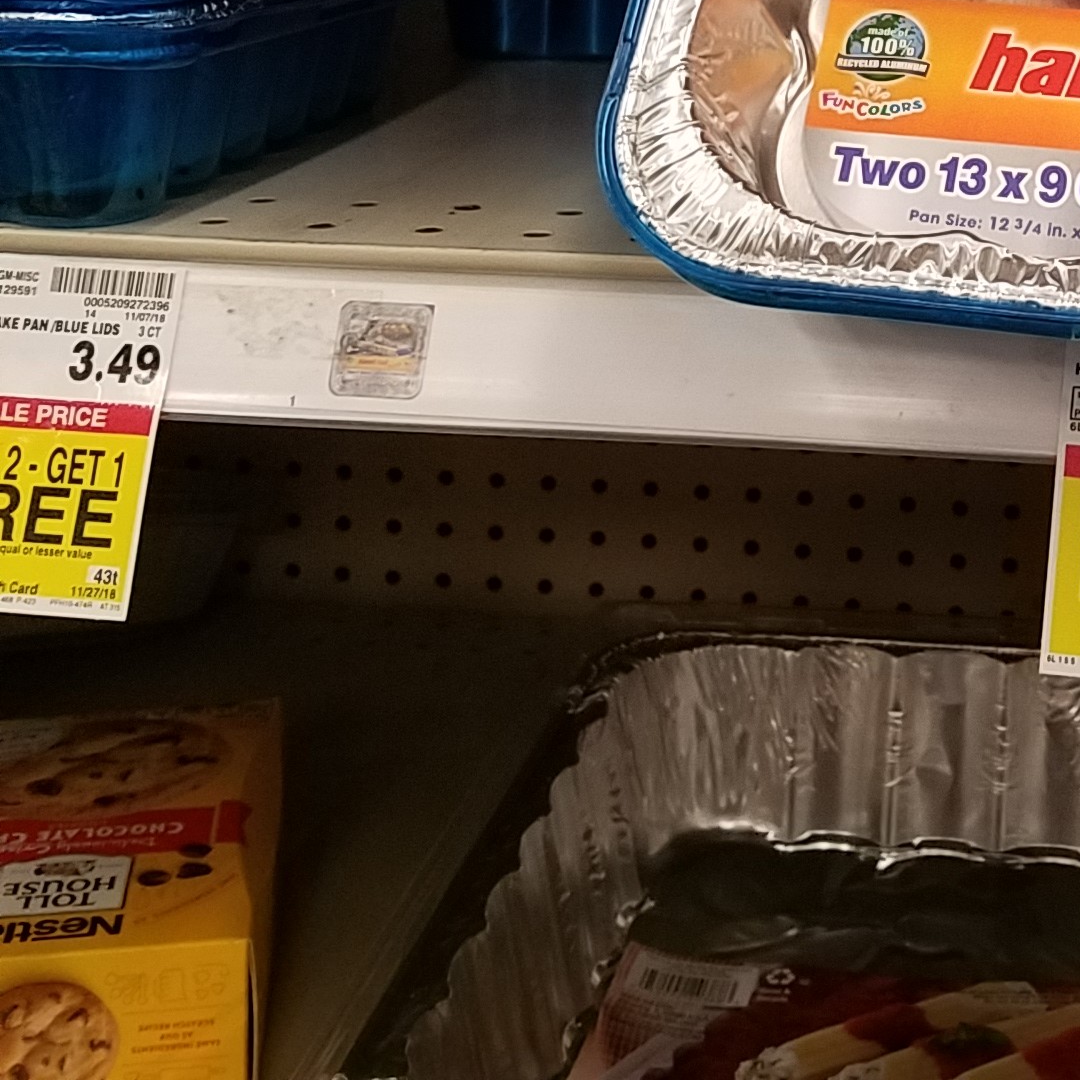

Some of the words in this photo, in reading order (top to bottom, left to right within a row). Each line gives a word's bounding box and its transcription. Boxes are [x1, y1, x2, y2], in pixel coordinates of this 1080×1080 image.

[868, 26, 896, 35] made
[898, 28, 910, 37] of
[861, 36, 915, 57] 100%
[837, 57, 880, 69] RECYCLED
[881, 60, 928, 72] ALUMINUM
[834, 145, 926, 190] Two
[939, 157, 988, 196] 13
[1000, 171, 1029, 199] x
[1039, 166, 1068, 203] 9
[909, 209, 940, 225] Pan
[945, 213, 982, 230] Size:
[990, 217, 1010, 232] 12
[1014, 217, 1042, 237] 3/4
[1046, 222, 1068, 239] in.
[84, 297, 169, 311] 0005209272396
[85, 309, 96, 318] 14
[125, 312, 165, 323] 11/07/18
[23, 319, 49, 331] PAN
[92, 322, 120, 335] LIDS
[139, 325, 145, 336] 3
[148, 326, 161, 338] CT
[69, 340, 160, 385] 3.49
[36, 404, 108, 428] PRICE
[4, 445, 21, 480] 2
[47, 447, 105, 486] GET
[114, 452, 124, 487] 1
[94, 569, 118, 585] 43t
[9, 582, 38, 594] Card
[71, 586, 116, 599] 11/27/18
[38, 822, 184, 843] CHOCOLATE
[3, 876, 116, 892] HOUSE
[17, 893, 98, 910] TOLL
